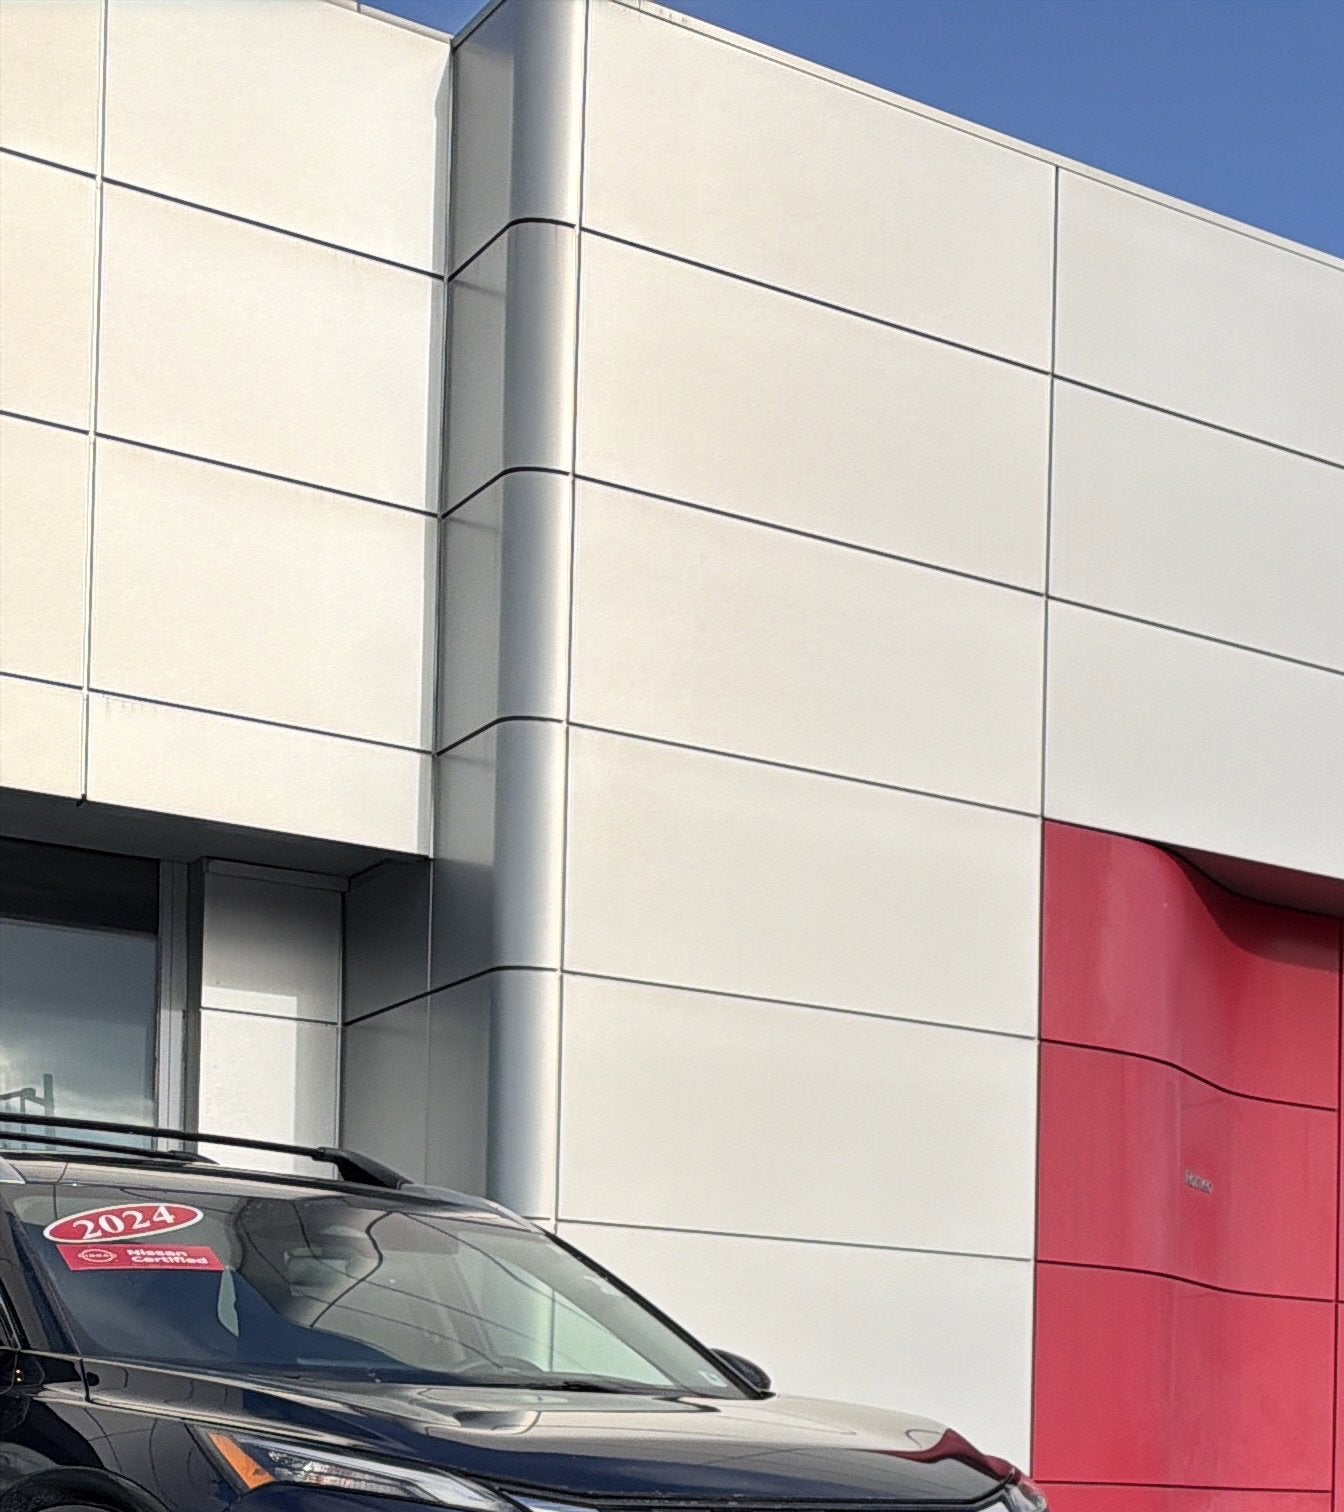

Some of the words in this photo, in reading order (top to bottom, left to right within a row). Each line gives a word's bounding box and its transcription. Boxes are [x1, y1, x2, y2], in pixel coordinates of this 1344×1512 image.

[72, 1205, 176, 1240] 2024
[126, 1248, 188, 1258] Nissan
[131, 1255, 209, 1265] Certified
